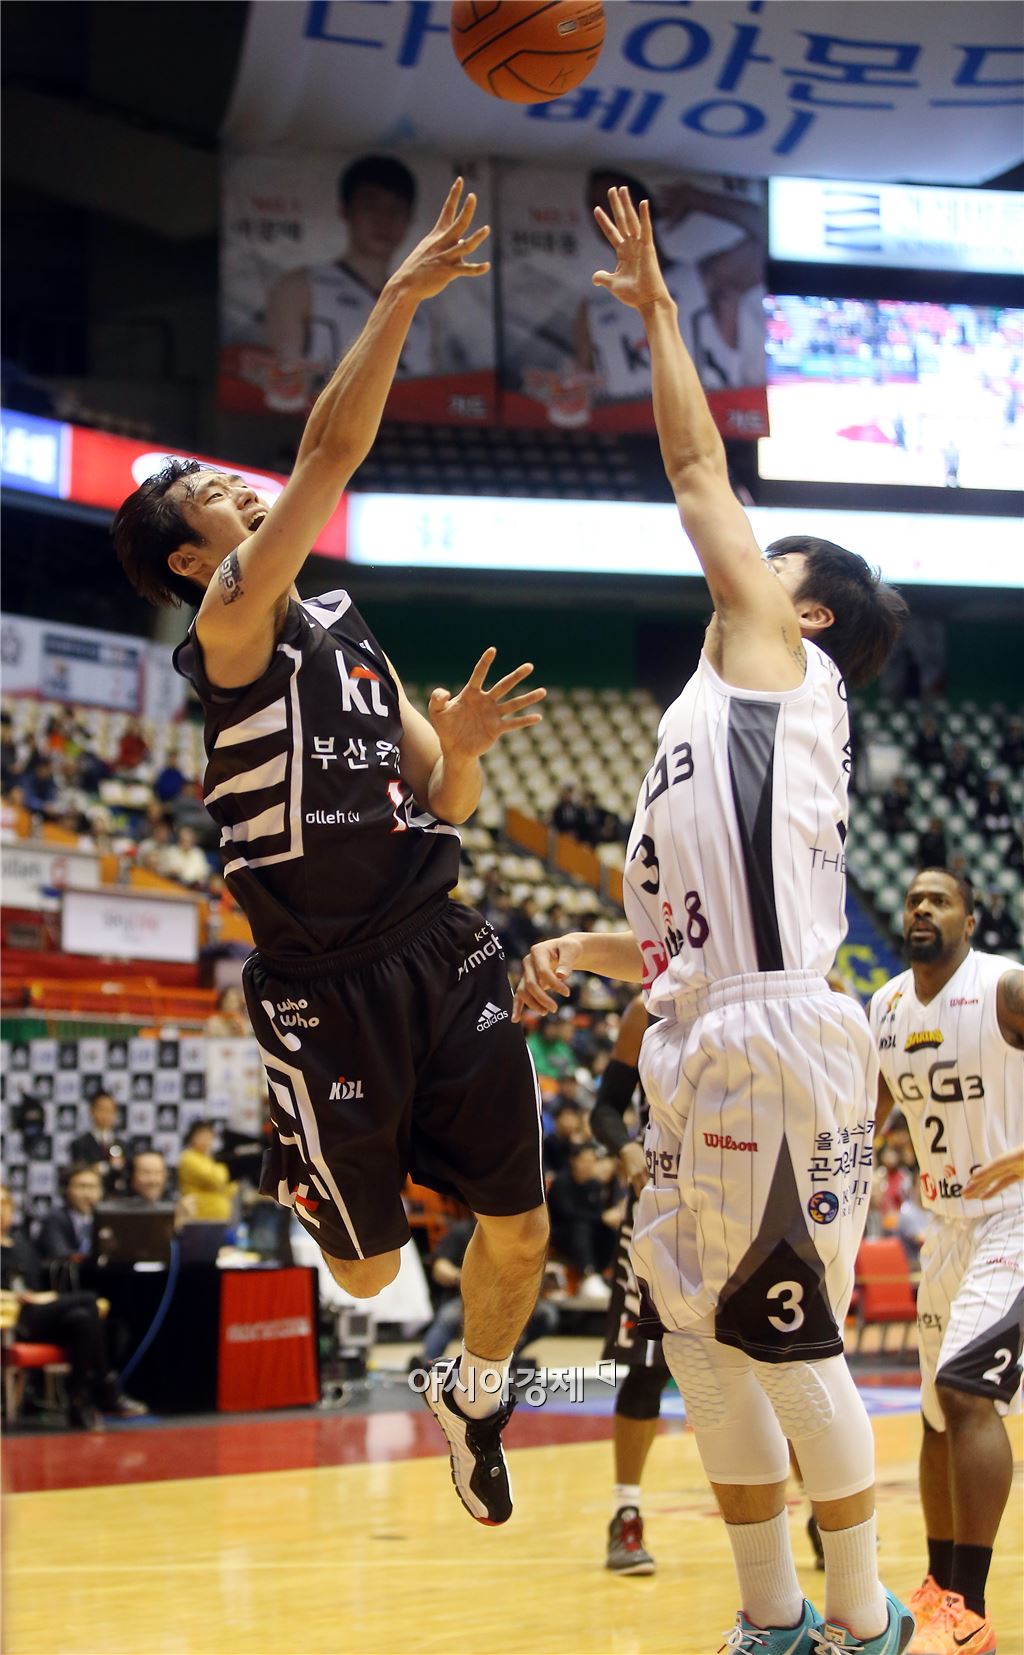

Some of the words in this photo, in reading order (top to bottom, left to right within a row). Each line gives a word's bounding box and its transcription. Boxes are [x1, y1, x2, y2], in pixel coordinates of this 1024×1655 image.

[335, 649, 389, 717] kt
[305, 809, 345, 825] olleh
[476, 1010, 509, 1032] adidas
[703, 1132, 759, 1152] Wilson
[924, 1115, 947, 1154] 2
[766, 1280, 805, 1334] 3
[982, 1348, 1012, 1385] 2
